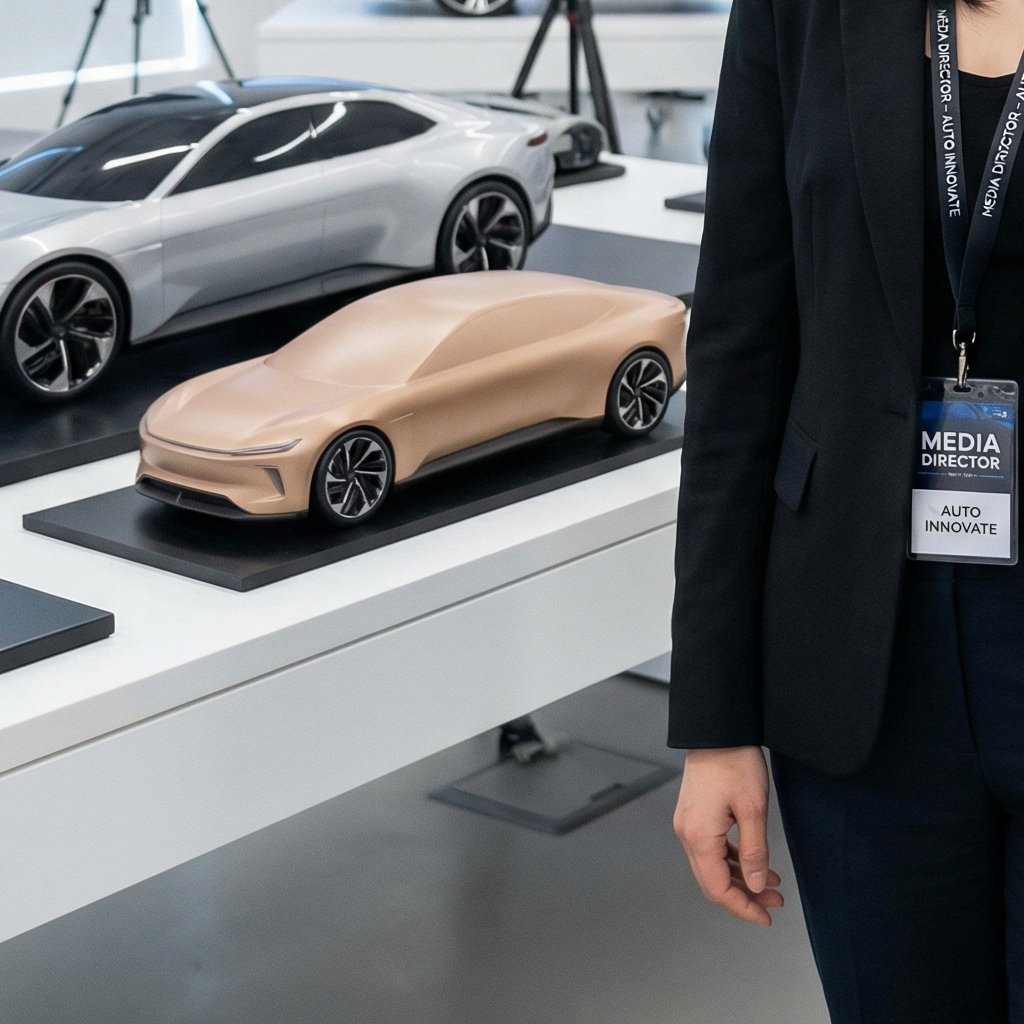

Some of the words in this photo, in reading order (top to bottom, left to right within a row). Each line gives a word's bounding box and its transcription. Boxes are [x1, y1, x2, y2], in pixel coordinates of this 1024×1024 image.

[942, 115, 956, 150] AUTO
[982, 177, 1002, 218] MEDIA
[992, 111, 1022, 174] DIRECTOR
[945, 152, 961, 218] INNOVATE
[921, 431, 1001, 453] MEDIA
[921, 453, 1000, 470] DIRECTOR
[941, 505, 981, 518] AUTO
[925, 520, 997, 535] INNOVATE
